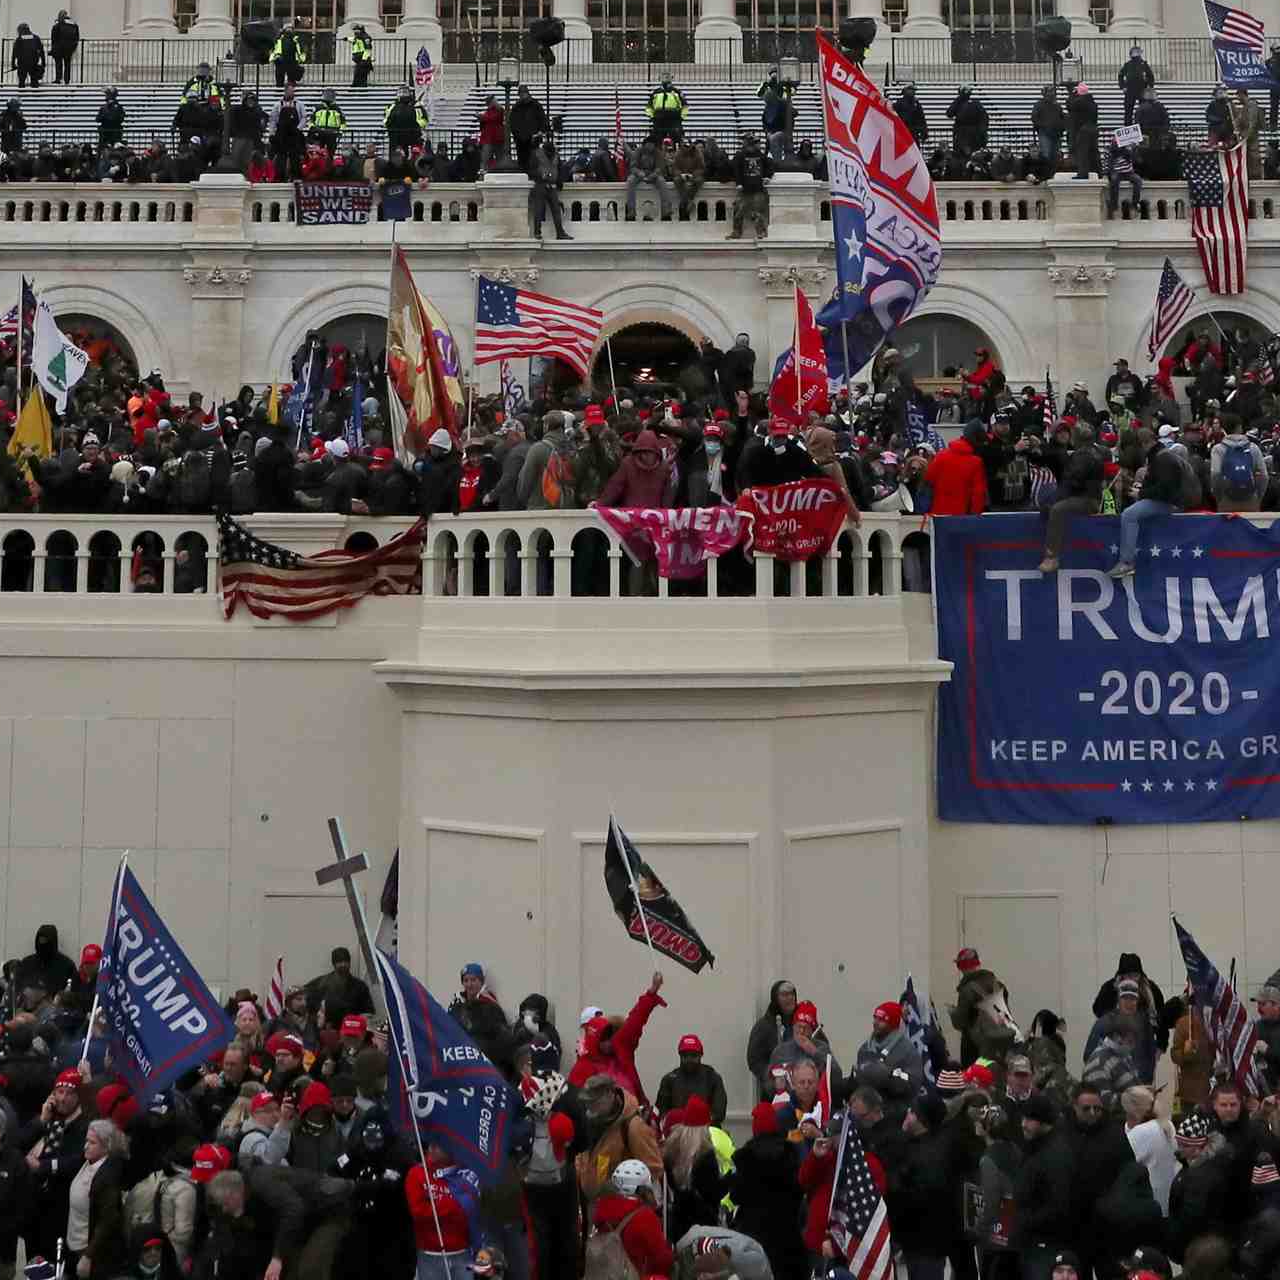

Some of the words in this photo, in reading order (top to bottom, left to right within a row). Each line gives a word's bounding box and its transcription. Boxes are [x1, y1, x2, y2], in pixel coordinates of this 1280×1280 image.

[303, 186, 371, 198] UNITED
[322, 199, 352, 210] WE
[751, 486, 835, 517] RUMP
[608, 505, 741, 537] OMEN
[1078, 670, 1258, 716] -2020-
[991, 739, 1067, 761] KEEP
[1081, 739, 1225, 761] AMERICA
